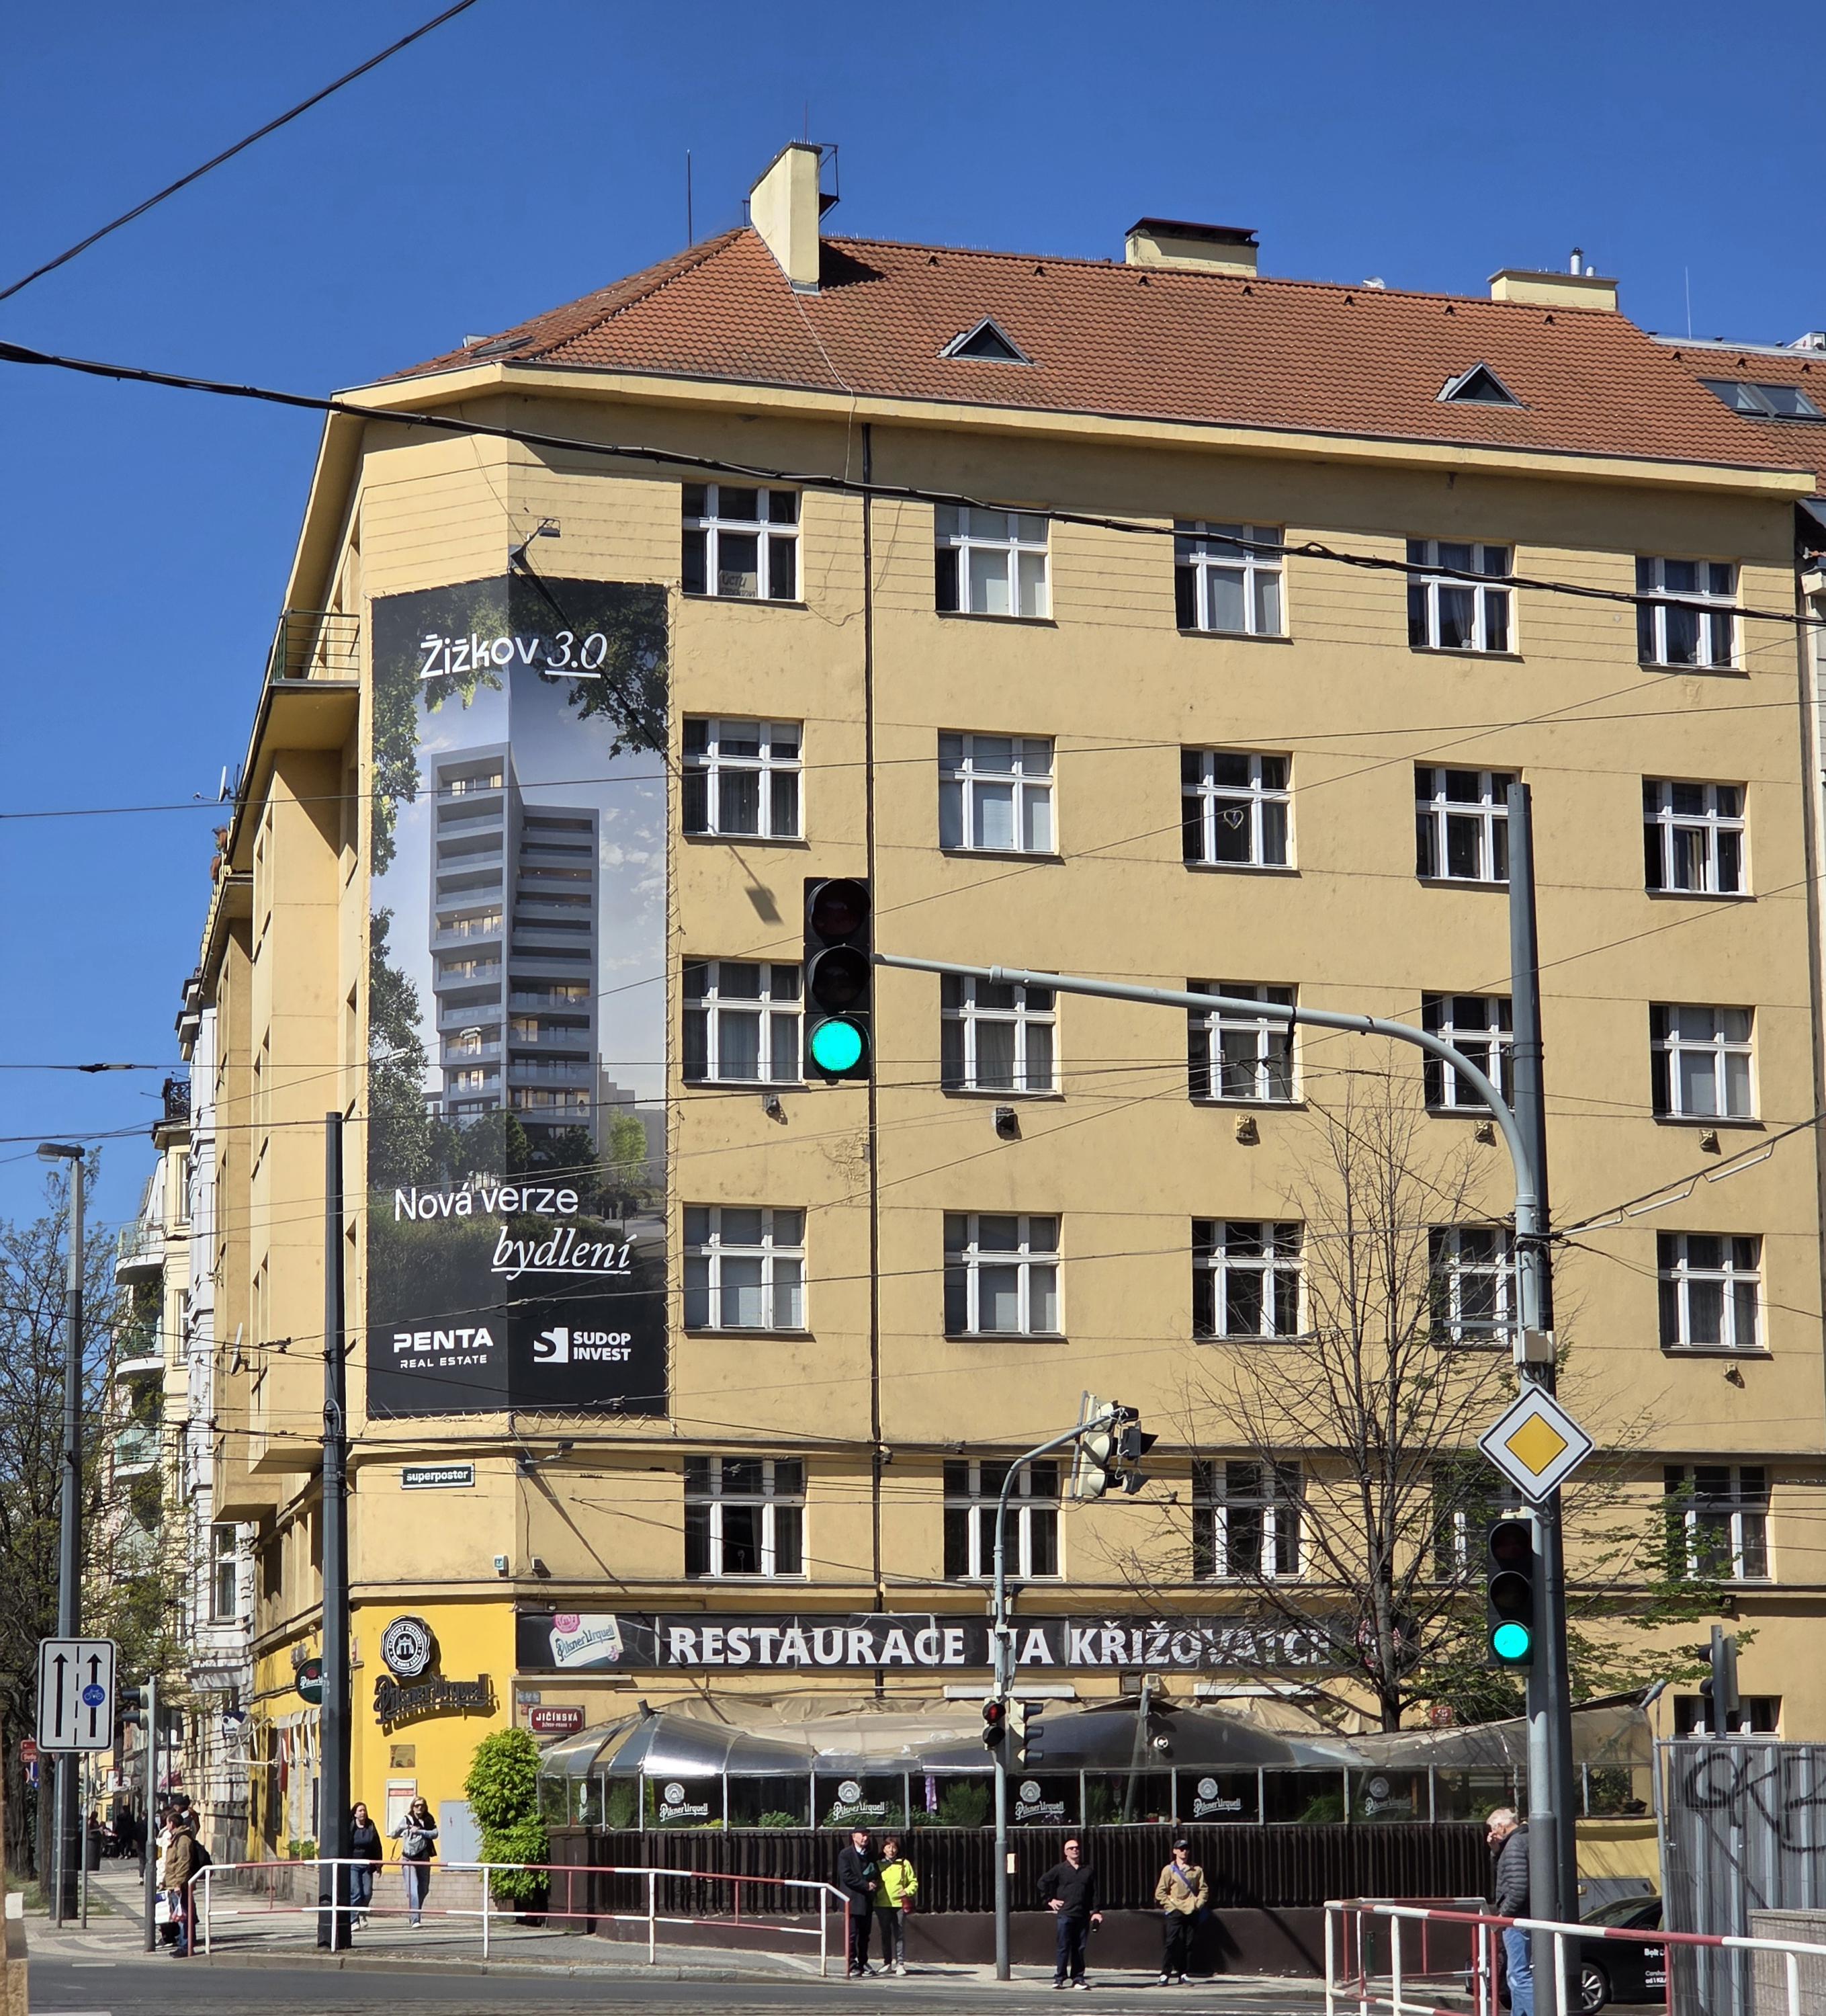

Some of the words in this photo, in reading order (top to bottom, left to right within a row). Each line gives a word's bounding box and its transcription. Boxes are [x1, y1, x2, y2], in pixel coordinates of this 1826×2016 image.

[421, 633, 539, 678] Žižkov
[547, 631, 607, 670] 3.0
[395, 1183, 472, 1221] Nová
[481, 1187, 578, 1214] verze
[491, 1226, 638, 1280] bydlení
[394, 1328, 493, 1353] PENTA
[573, 1331, 631, 1346] SUDOP
[400, 1358, 434, 1369] REAL
[439, 1355, 487, 1367] ESTATE
[574, 1347, 632, 1361] INVEST
[406, 1470, 468, 1482] superposter
[555, 1635, 585, 1663] Pilsner
[582, 1624, 615, 1644] Urquell
[668, 1627, 965, 1665] RESTAURACE
[374, 1675, 431, 1724] Pilsner
[429, 1671, 490, 1709] Urquell
[535, 1711, 578, 1722] JIČÍNSKÁ
[659, 1803, 684, 1822] Pilsner
[683, 1802, 709, 1816] Urquell
[833, 1801, 859, 1821] Pilsner
[859, 1801, 885, 1815] Urquell
[1015, 1801, 1040, 1820] Pilsner
[1039, 1800, 1064, 1814] Urquell
[1193, 1798, 1218, 1817] Pilsner
[1217, 1797, 1241, 1811] Urquell
